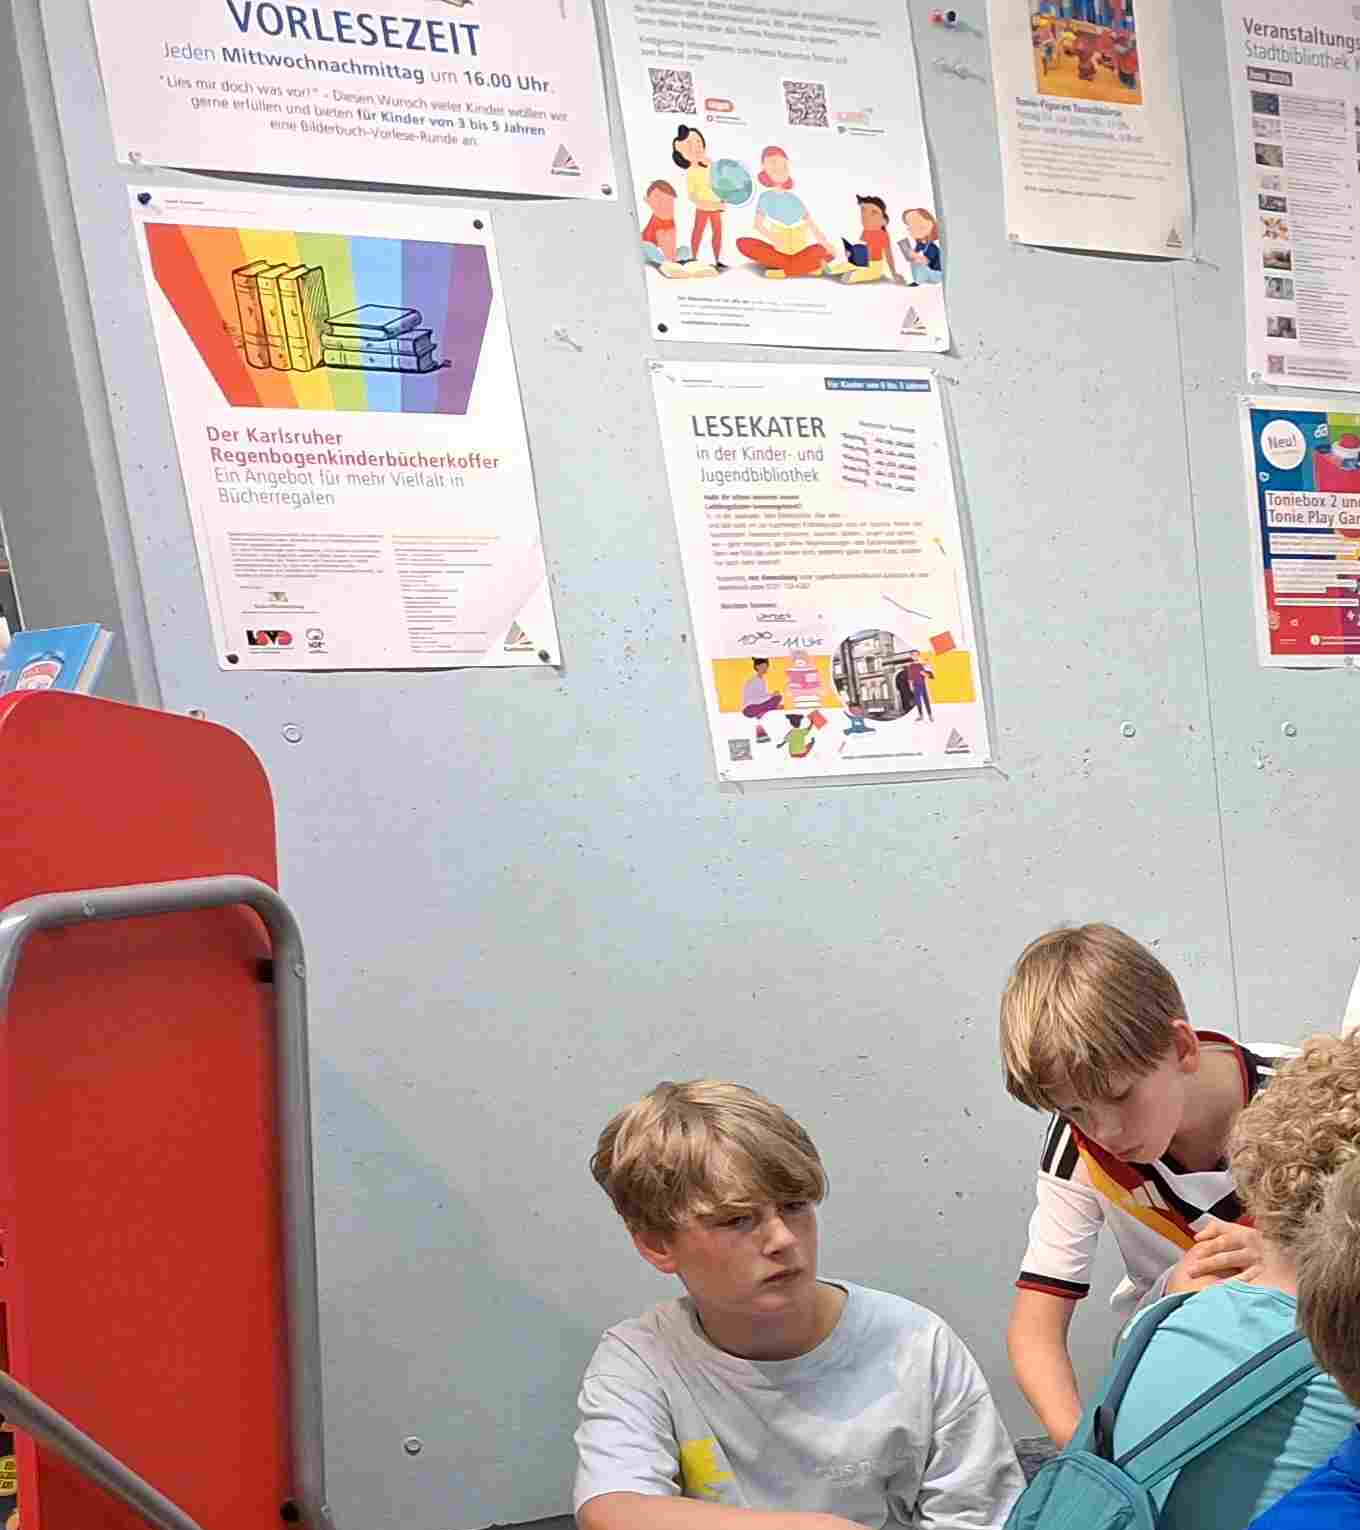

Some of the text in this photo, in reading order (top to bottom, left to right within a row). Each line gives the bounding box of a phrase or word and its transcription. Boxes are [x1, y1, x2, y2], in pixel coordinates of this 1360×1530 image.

[226, 0, 480, 56] VORLESEZEIT
[1244, 40, 1349, 71] Stadtbibliothek
[162, 41, 556, 94] Jeden Mittwochnachmittag um 16.00 Uhr.
[221, 80, 254, 95] doch
[258, 85, 283, 96] was
[377, 94, 428, 110] Wunsch
[286, 102, 311, 116] und
[314, 104, 353, 118] bieten
[357, 107, 377, 120] für
[381, 111, 425, 126] Kinder
[430, 117, 454, 128] von
[457, 116, 466, 128] 3
[469, 118, 489, 131] bis
[503, 120, 546, 136] Jahren
[206, 426, 343, 446] Der Karlsruher
[691, 415, 826, 439] LESEKATER
[1268, 434, 1297, 449] Neu!
[209, 446, 500, 470] Regenbogenkinderbücherkoffer
[696, 445, 824, 462] in der Kinder- und
[214, 468, 465, 489] Ein Angebot für mehr Vielfalt in
[700, 467, 820, 487] Jugendbibliothek
[217, 488, 336, 509] Bücherregalen
[1267, 493, 1326, 508] Toniebox
[1330, 495, 1338, 508] 2
[1268, 510, 1304, 523] Tonie
[1307, 510, 1335, 527] Play
